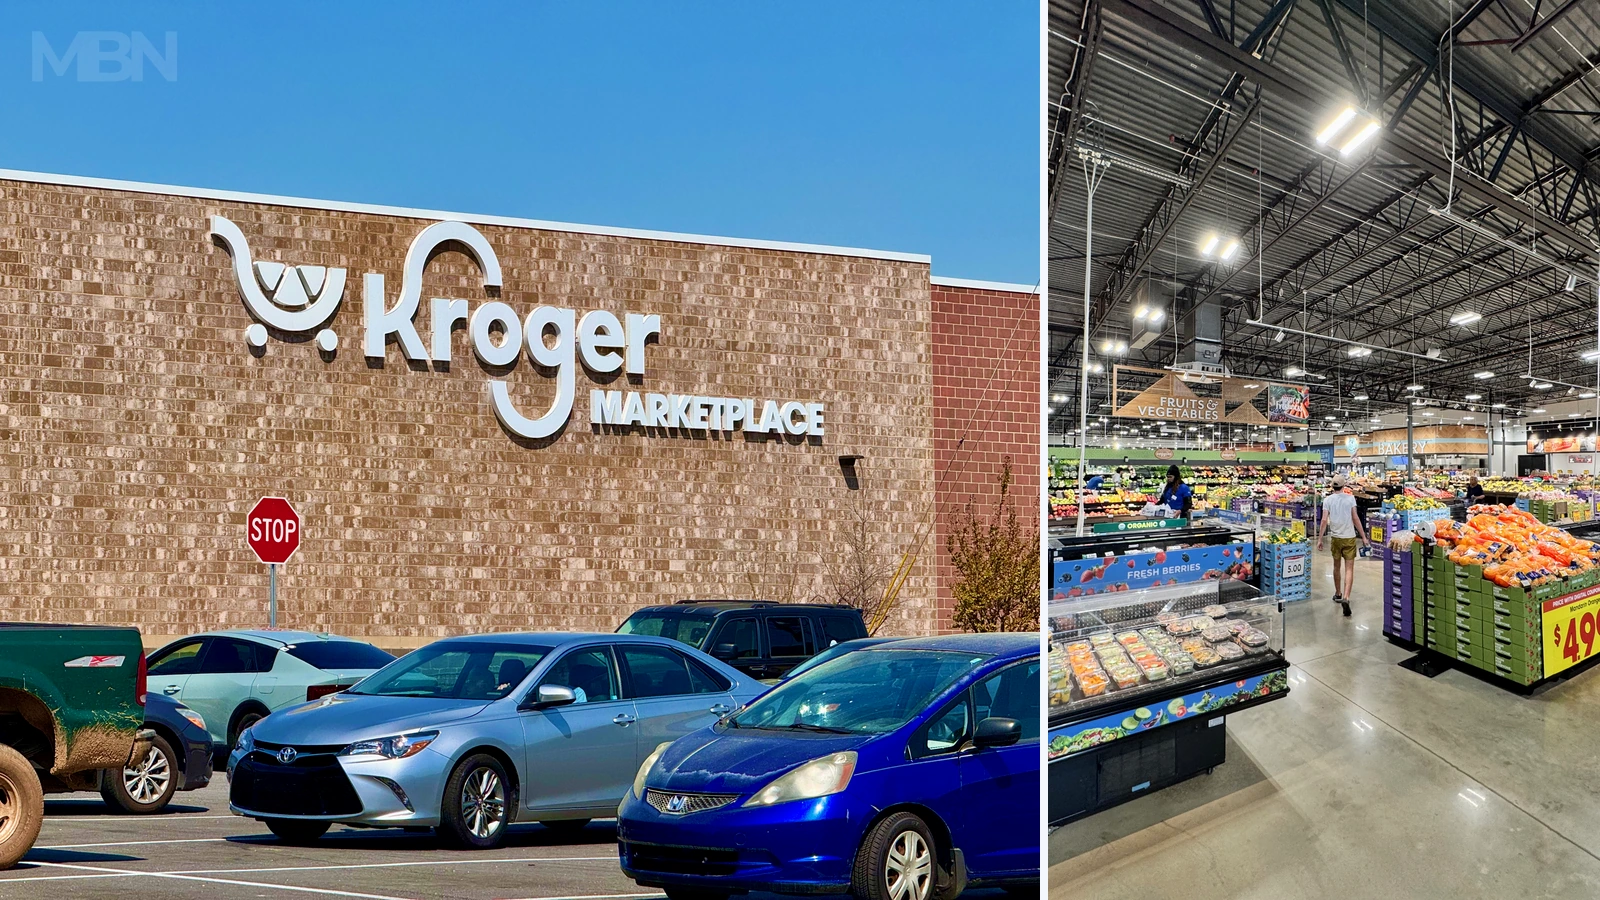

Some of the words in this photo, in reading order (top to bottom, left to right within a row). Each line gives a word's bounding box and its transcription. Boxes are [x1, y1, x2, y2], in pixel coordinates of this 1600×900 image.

[363, 220, 660, 439] Kroger
[1160, 397, 1204, 409] FRUITS
[1206, 399, 1218, 410] &
[590, 389, 824, 436] MARKETPLACE
[1138, 405, 1218, 420] VEGETABLES
[1378, 441, 1426, 455] BAKERY
[251, 517, 296, 543] STOP
[1127, 522, 1158, 530] ORGANIC
[1127, 568, 1159, 580] FRESH
[1162, 563, 1201, 575] BERRIES
[1287, 563, 1302, 573] 5.00
[1553, 598, 1564, 608] PRICE
[1570, 602, 1587, 613] Mandarin
